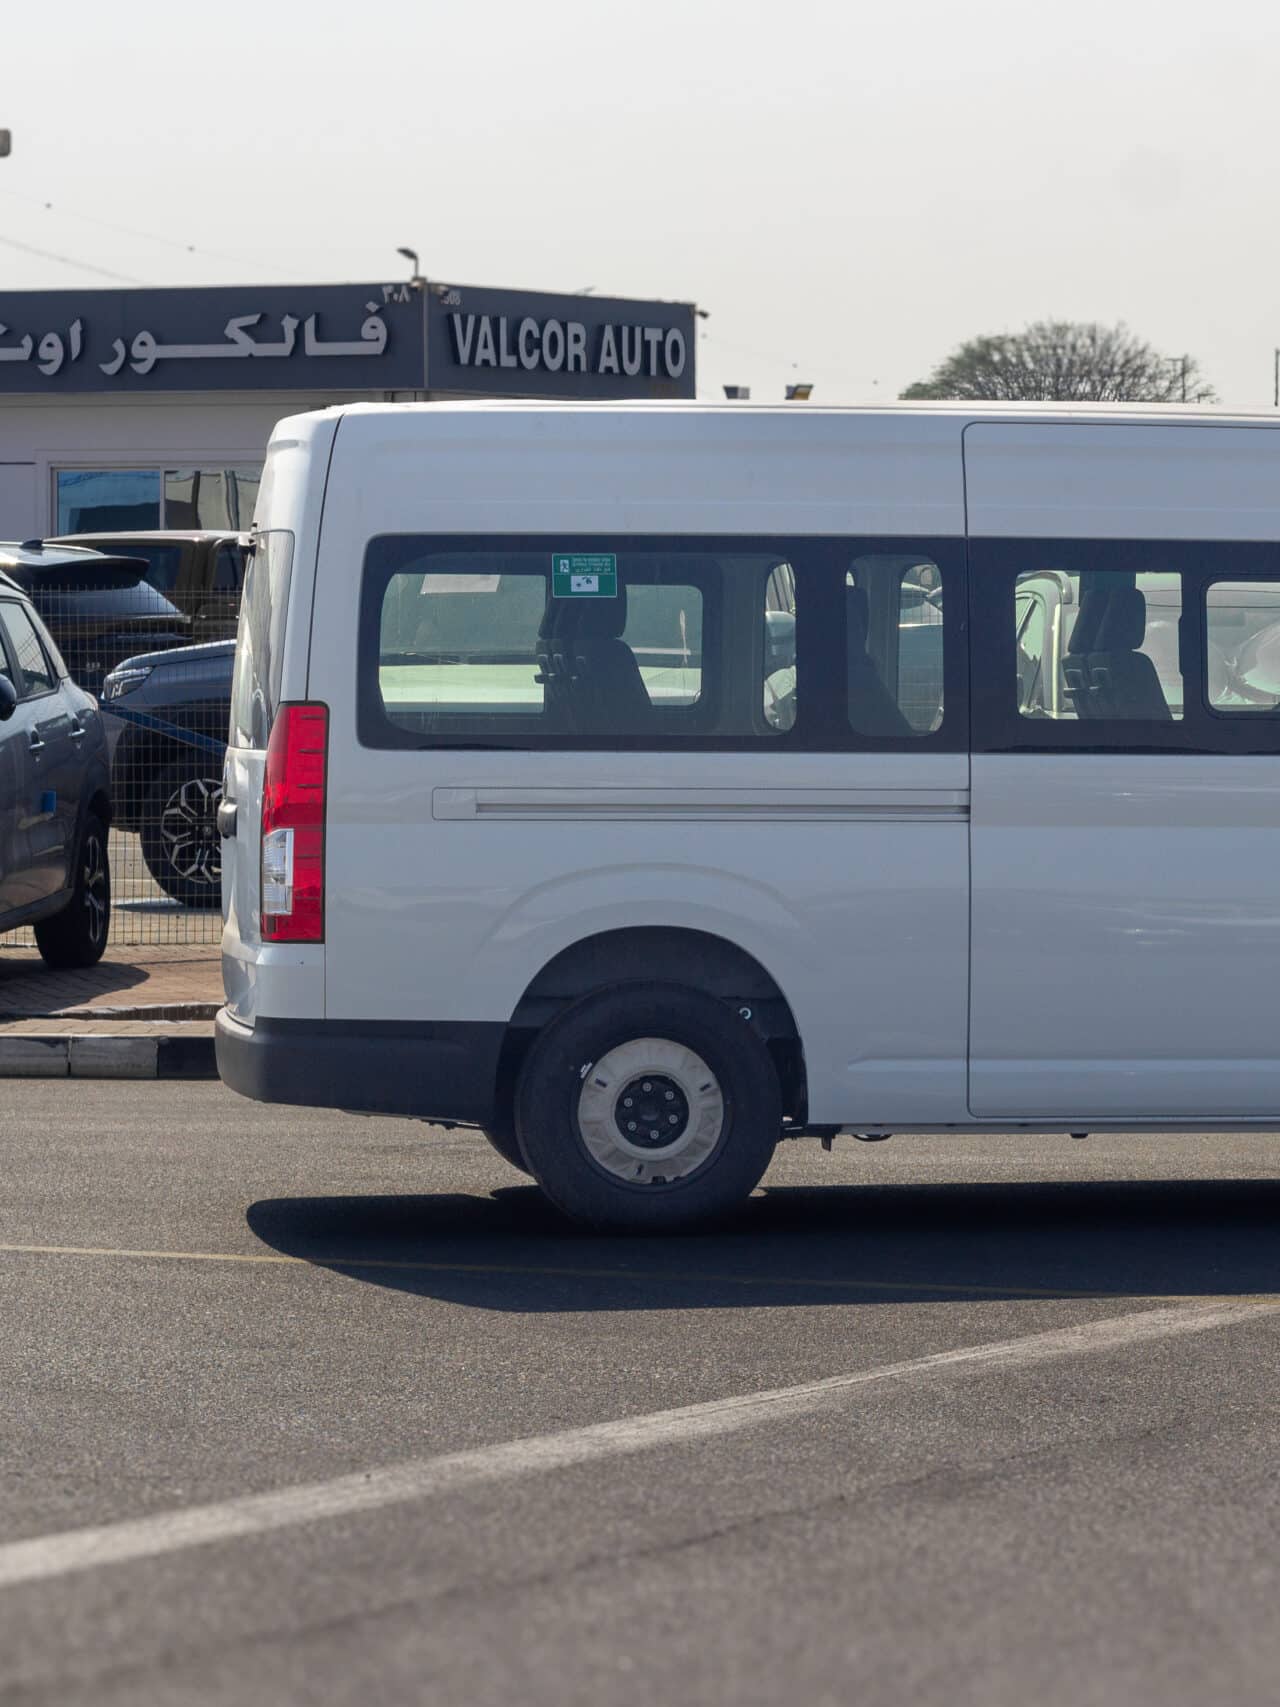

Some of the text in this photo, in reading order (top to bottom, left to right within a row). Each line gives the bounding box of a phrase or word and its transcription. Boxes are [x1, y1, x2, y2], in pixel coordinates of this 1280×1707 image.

[0, 301, 389, 376] فالكور اوت
[453, 313, 686, 379] VALCOR AUTO
